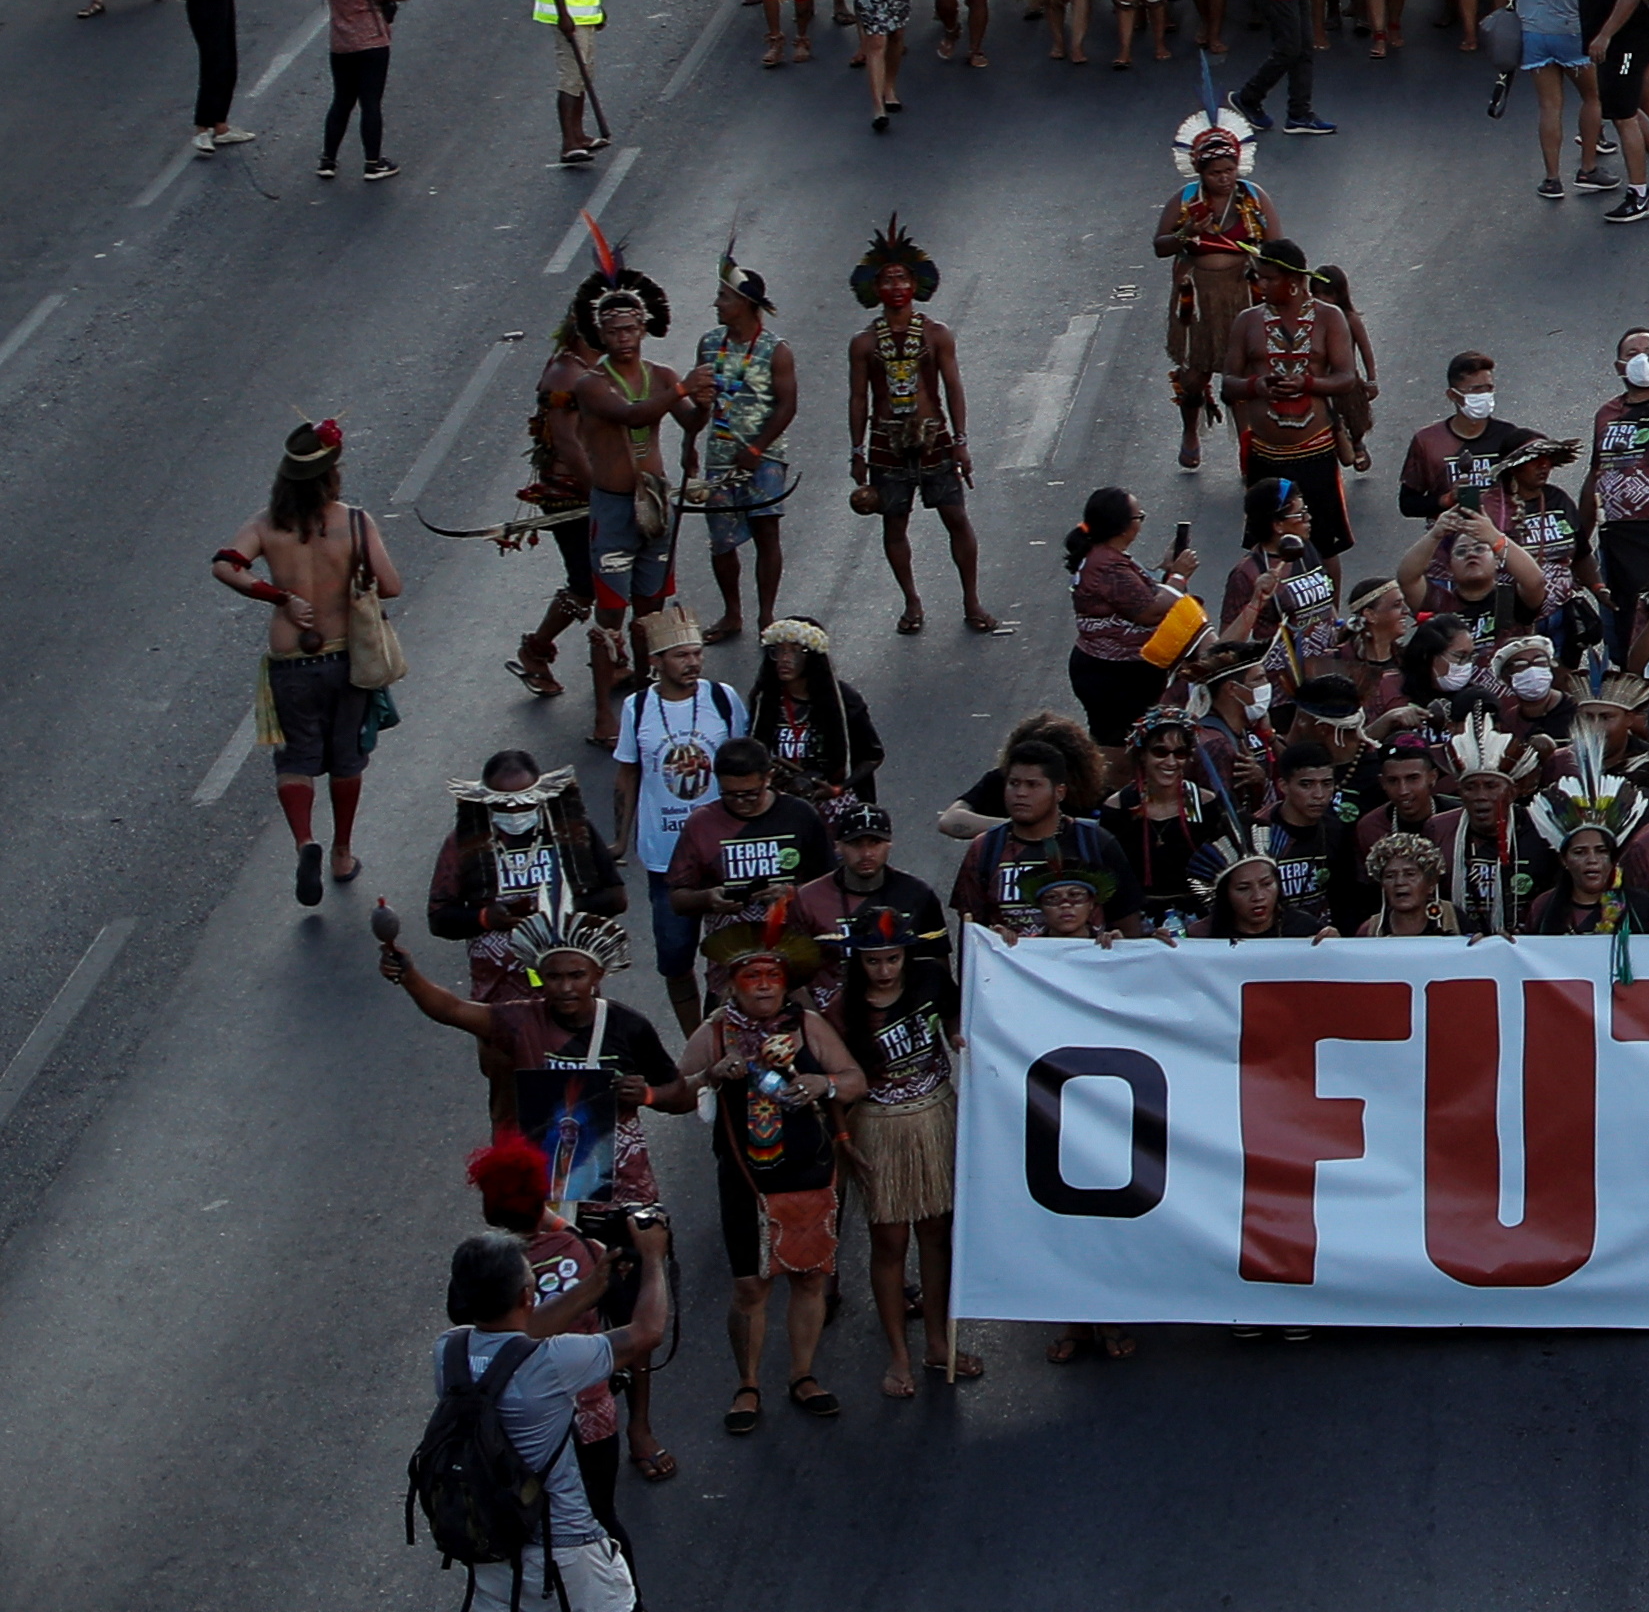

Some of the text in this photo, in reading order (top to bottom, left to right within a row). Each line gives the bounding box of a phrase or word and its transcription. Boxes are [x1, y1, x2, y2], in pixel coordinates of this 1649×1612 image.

[725, 842, 779, 861] TERRA
[727, 857, 781, 879] LIVRE
[1025, 1046, 1169, 1218] O
